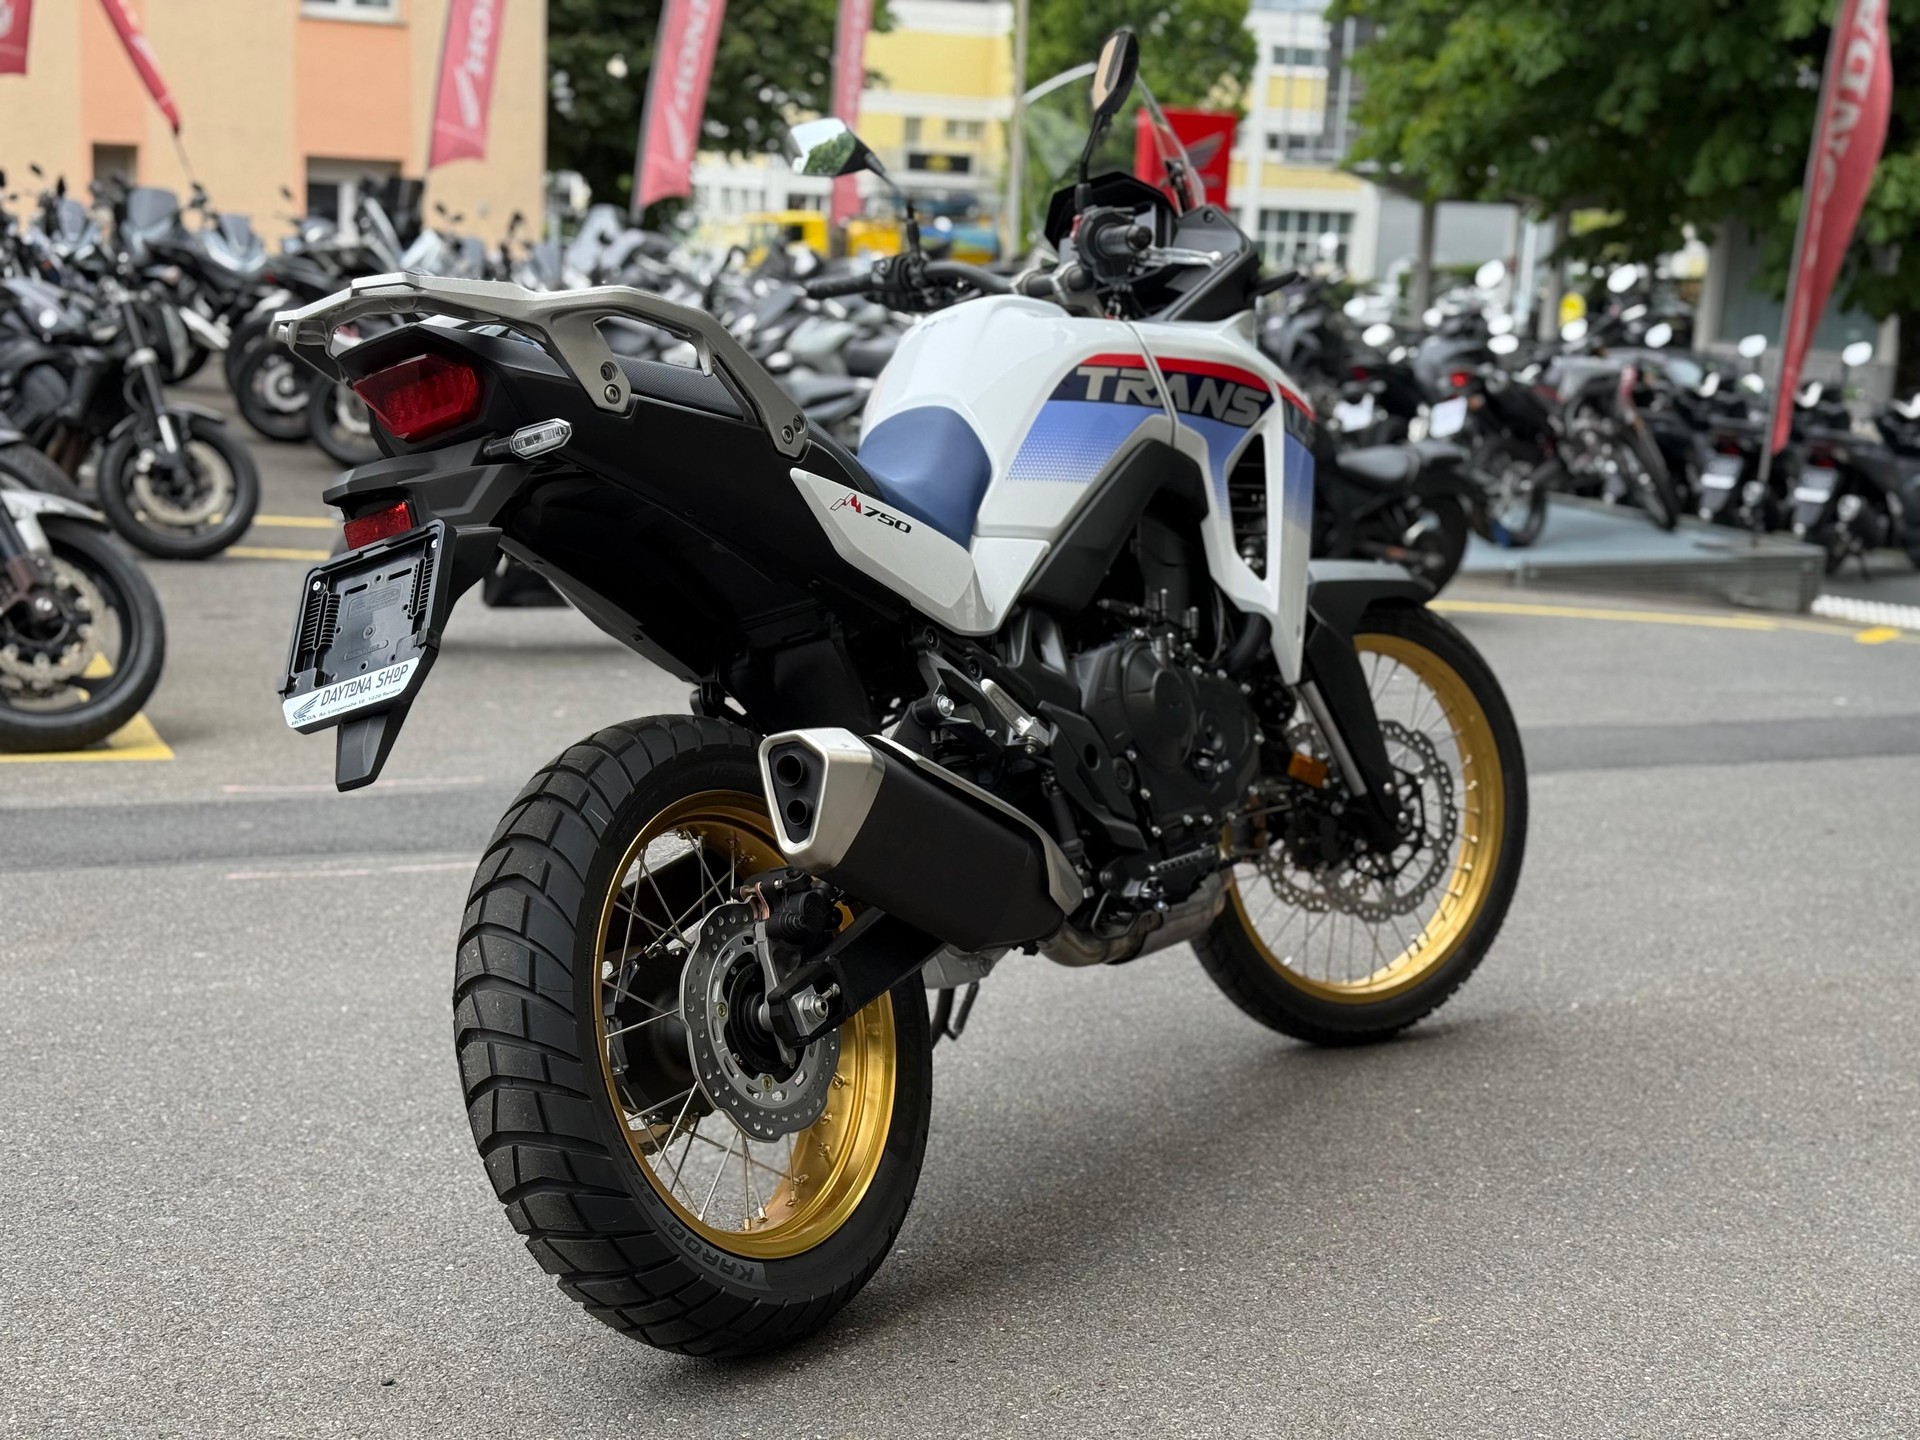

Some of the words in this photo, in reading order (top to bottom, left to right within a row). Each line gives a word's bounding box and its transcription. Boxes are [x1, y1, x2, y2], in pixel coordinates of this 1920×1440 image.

[1077, 366, 1268, 426] TRANS
[320, 676, 372, 707] DAYTONA
[376, 664, 409, 689] SHOP
